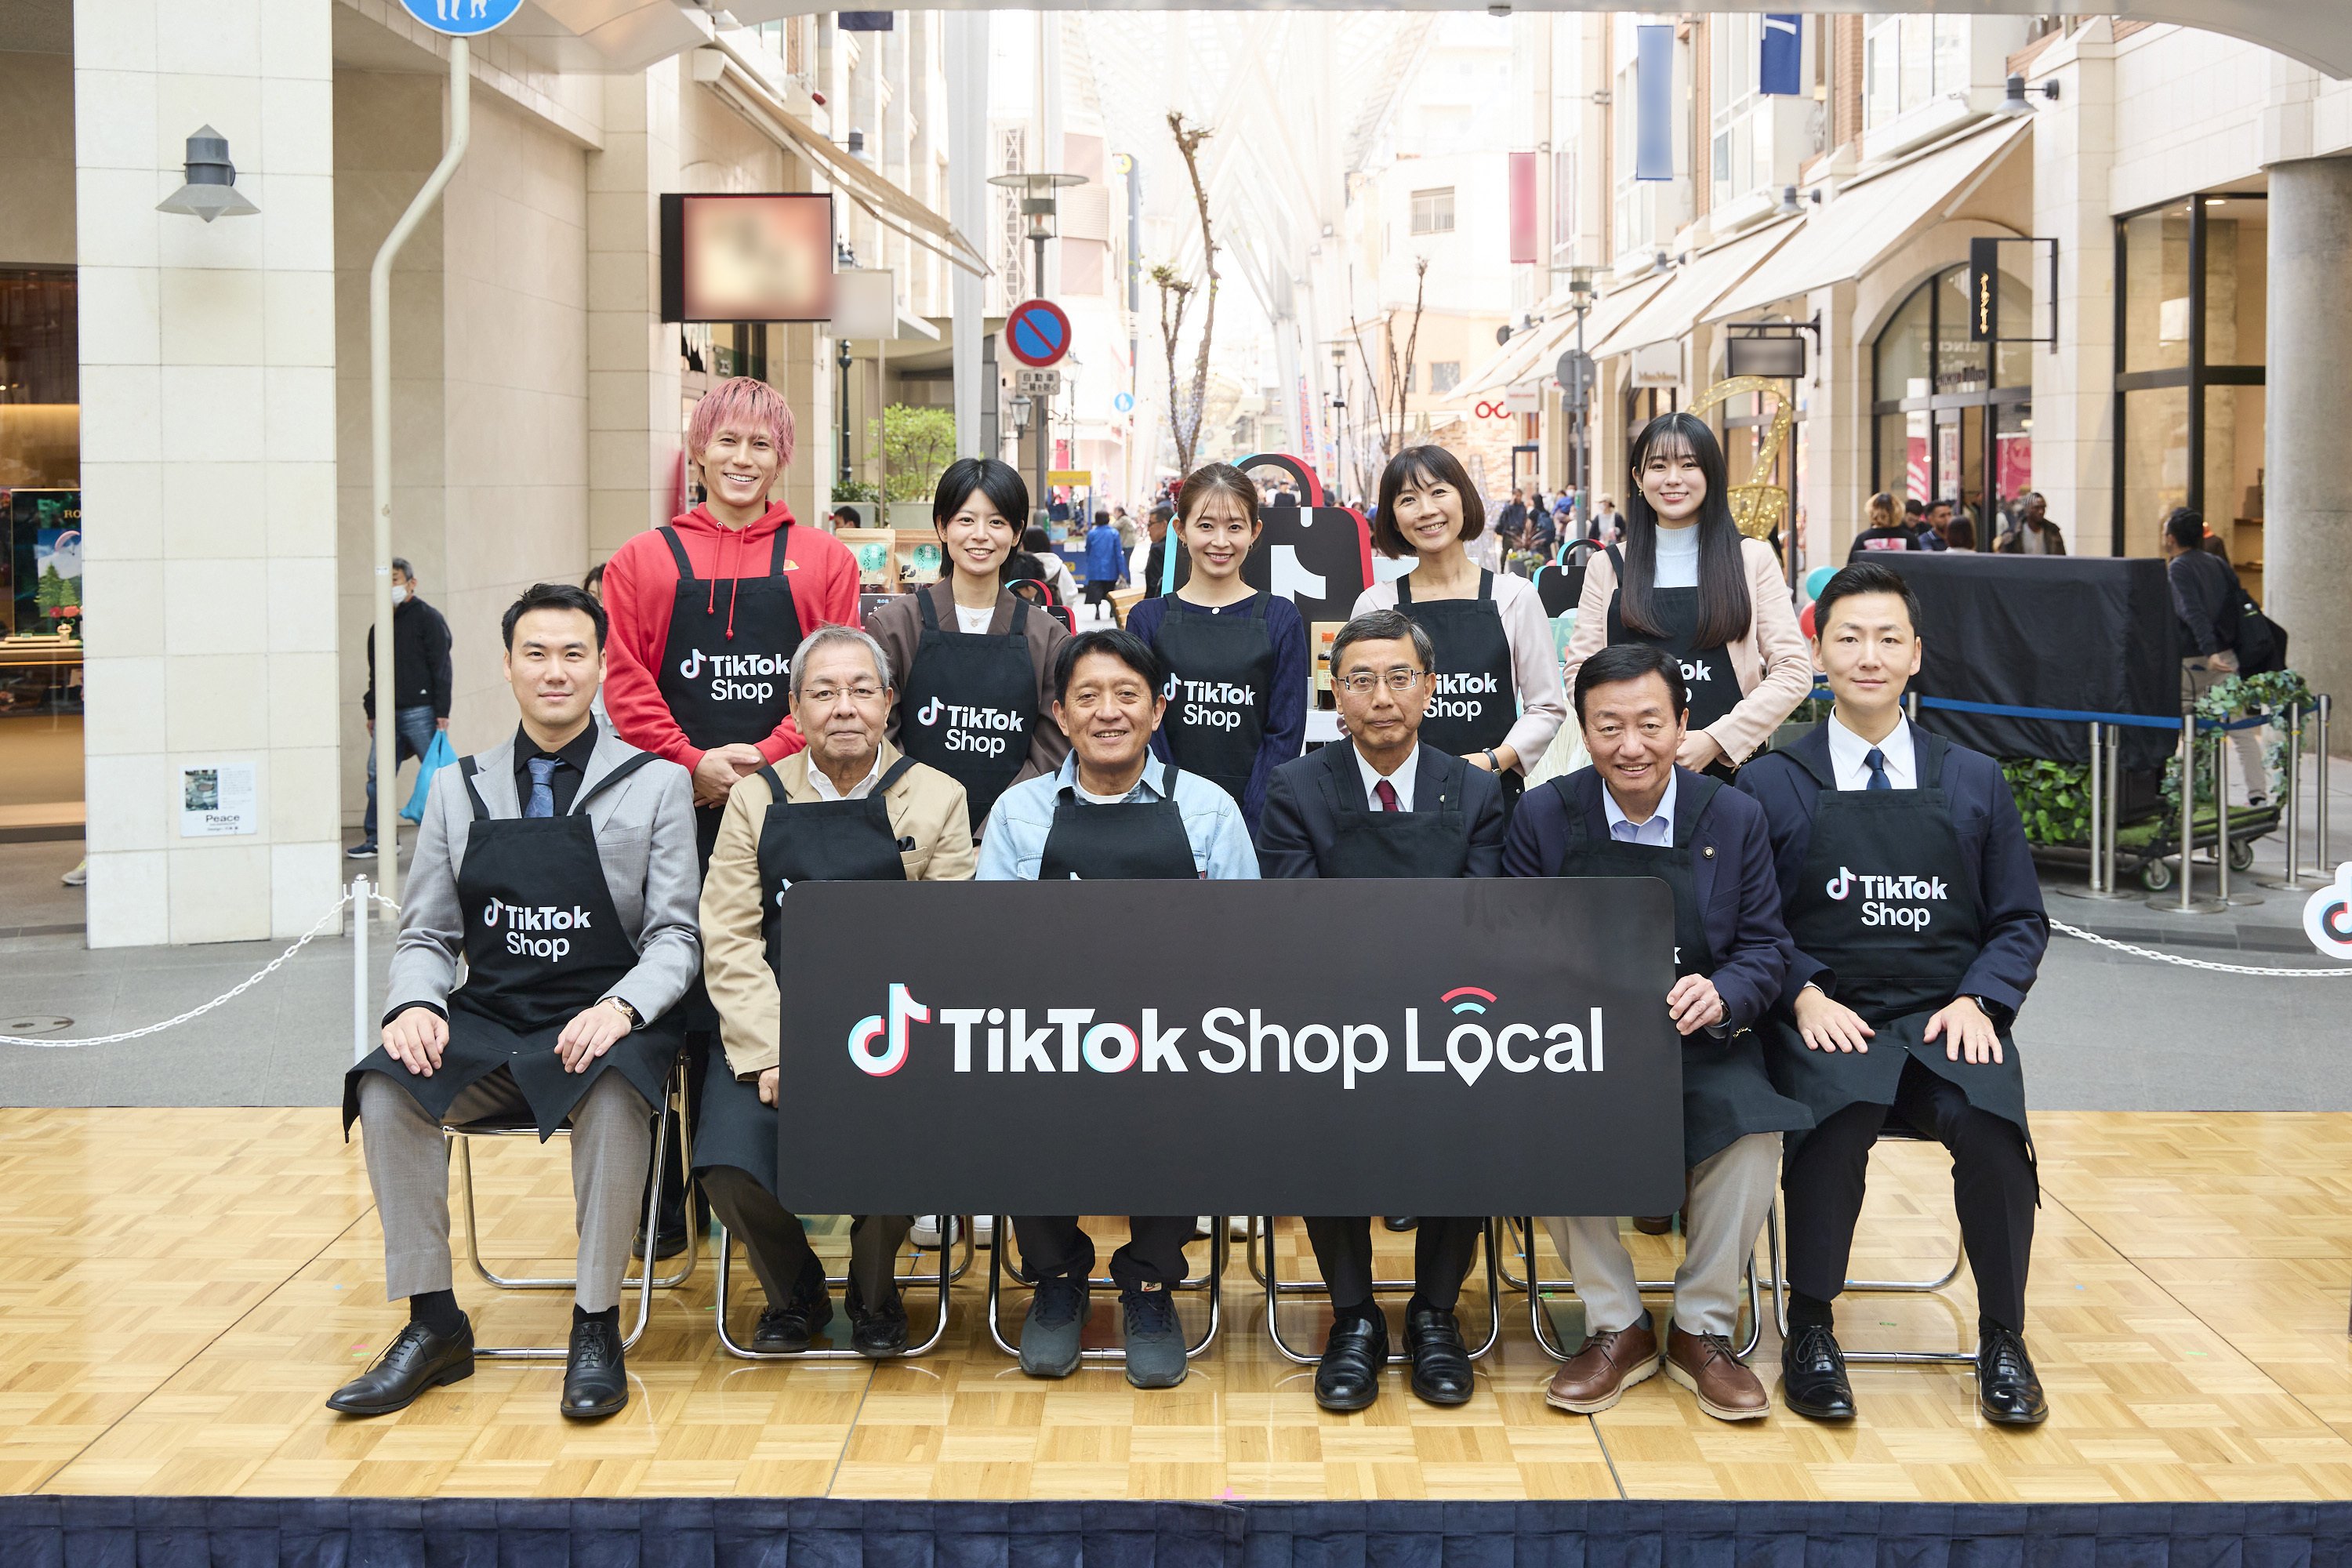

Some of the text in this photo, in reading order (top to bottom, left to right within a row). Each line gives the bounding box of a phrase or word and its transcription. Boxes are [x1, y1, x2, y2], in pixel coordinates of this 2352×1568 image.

[1023, 373, 1054, 382] 自動車
[709, 654, 790, 677] TikTok
[710, 678, 774, 704] Shop
[1183, 681, 1256, 706] TikTok
[1436, 673, 1498, 695] ikTok
[946, 706, 1025, 732] TikTok
[1182, 703, 1241, 731] Shop
[1423, 696, 1483, 721] Shop
[944, 729, 1006, 758] Shop
[1859, 875, 1948, 900] TikTok
[505, 905, 592, 931] TikTok
[1860, 902, 1931, 932] Shop
[506, 931, 570, 963] Shop
[939, 1007, 1604, 1090] TikTok Shop Local
